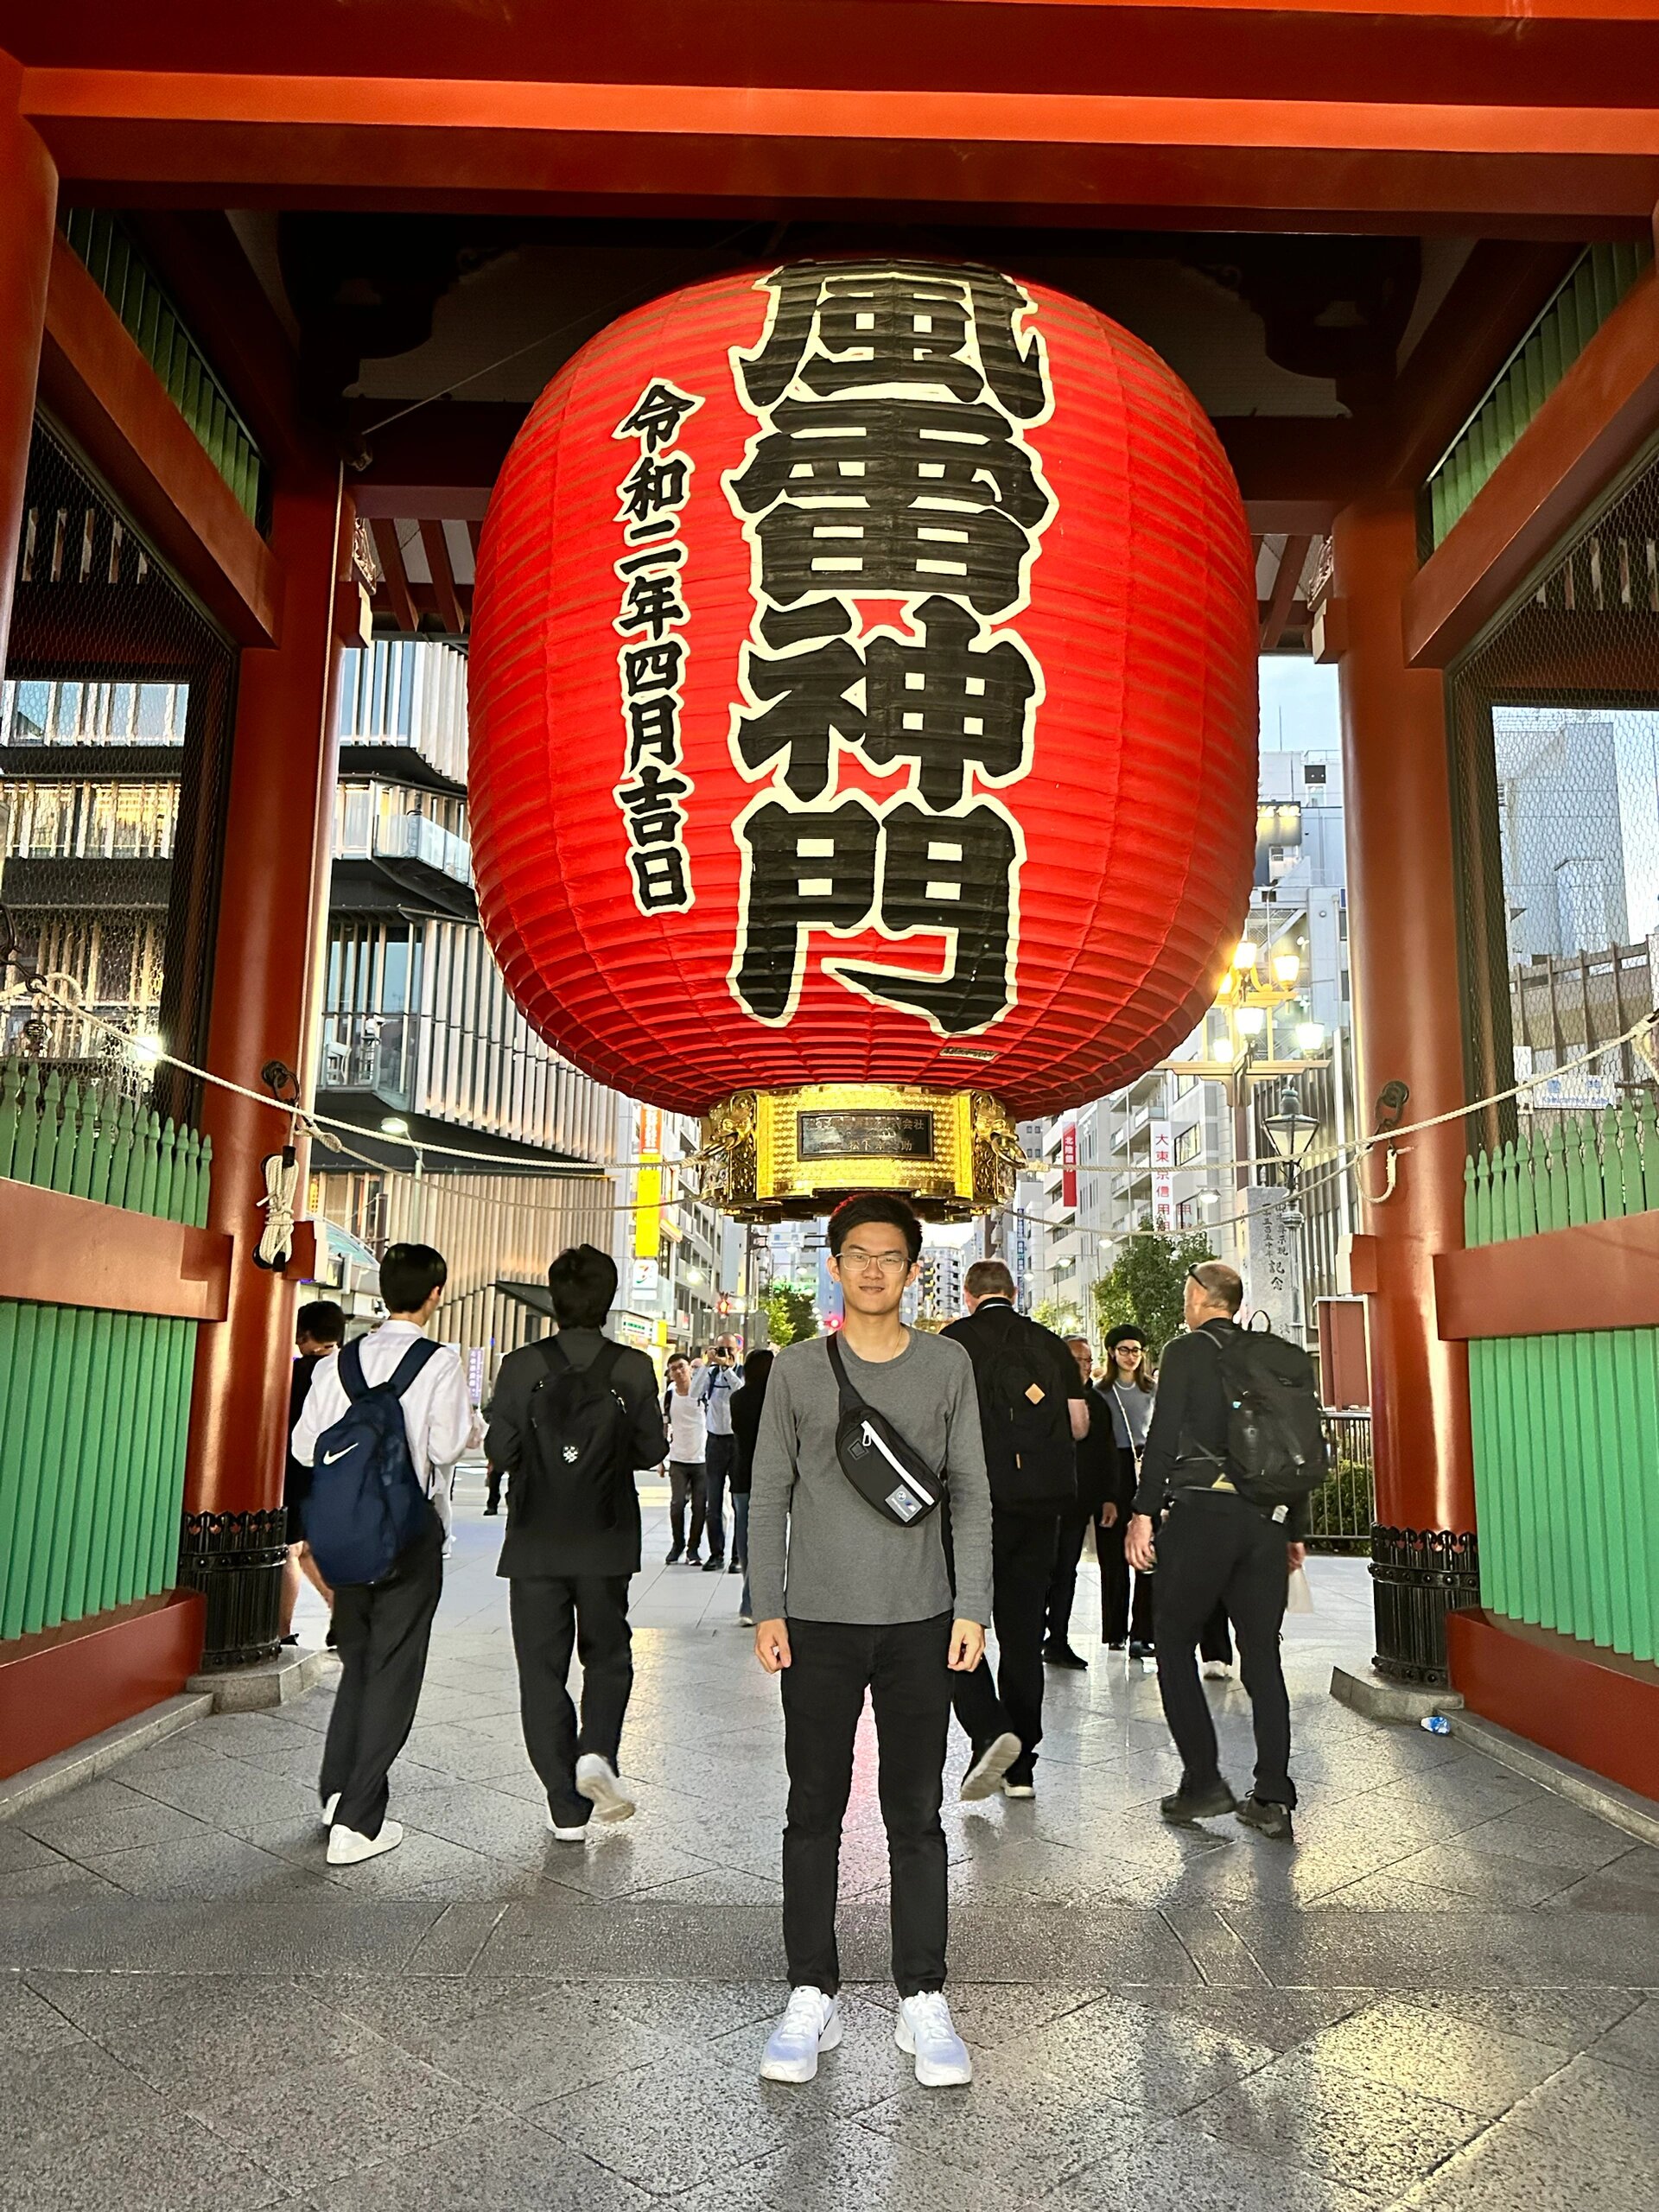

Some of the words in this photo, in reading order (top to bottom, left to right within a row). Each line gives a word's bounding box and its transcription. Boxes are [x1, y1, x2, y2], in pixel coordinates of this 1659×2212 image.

[614, 378, 702, 916] 令和二年四月吉日
[724, 258, 1057, 1035] 風雷神門
